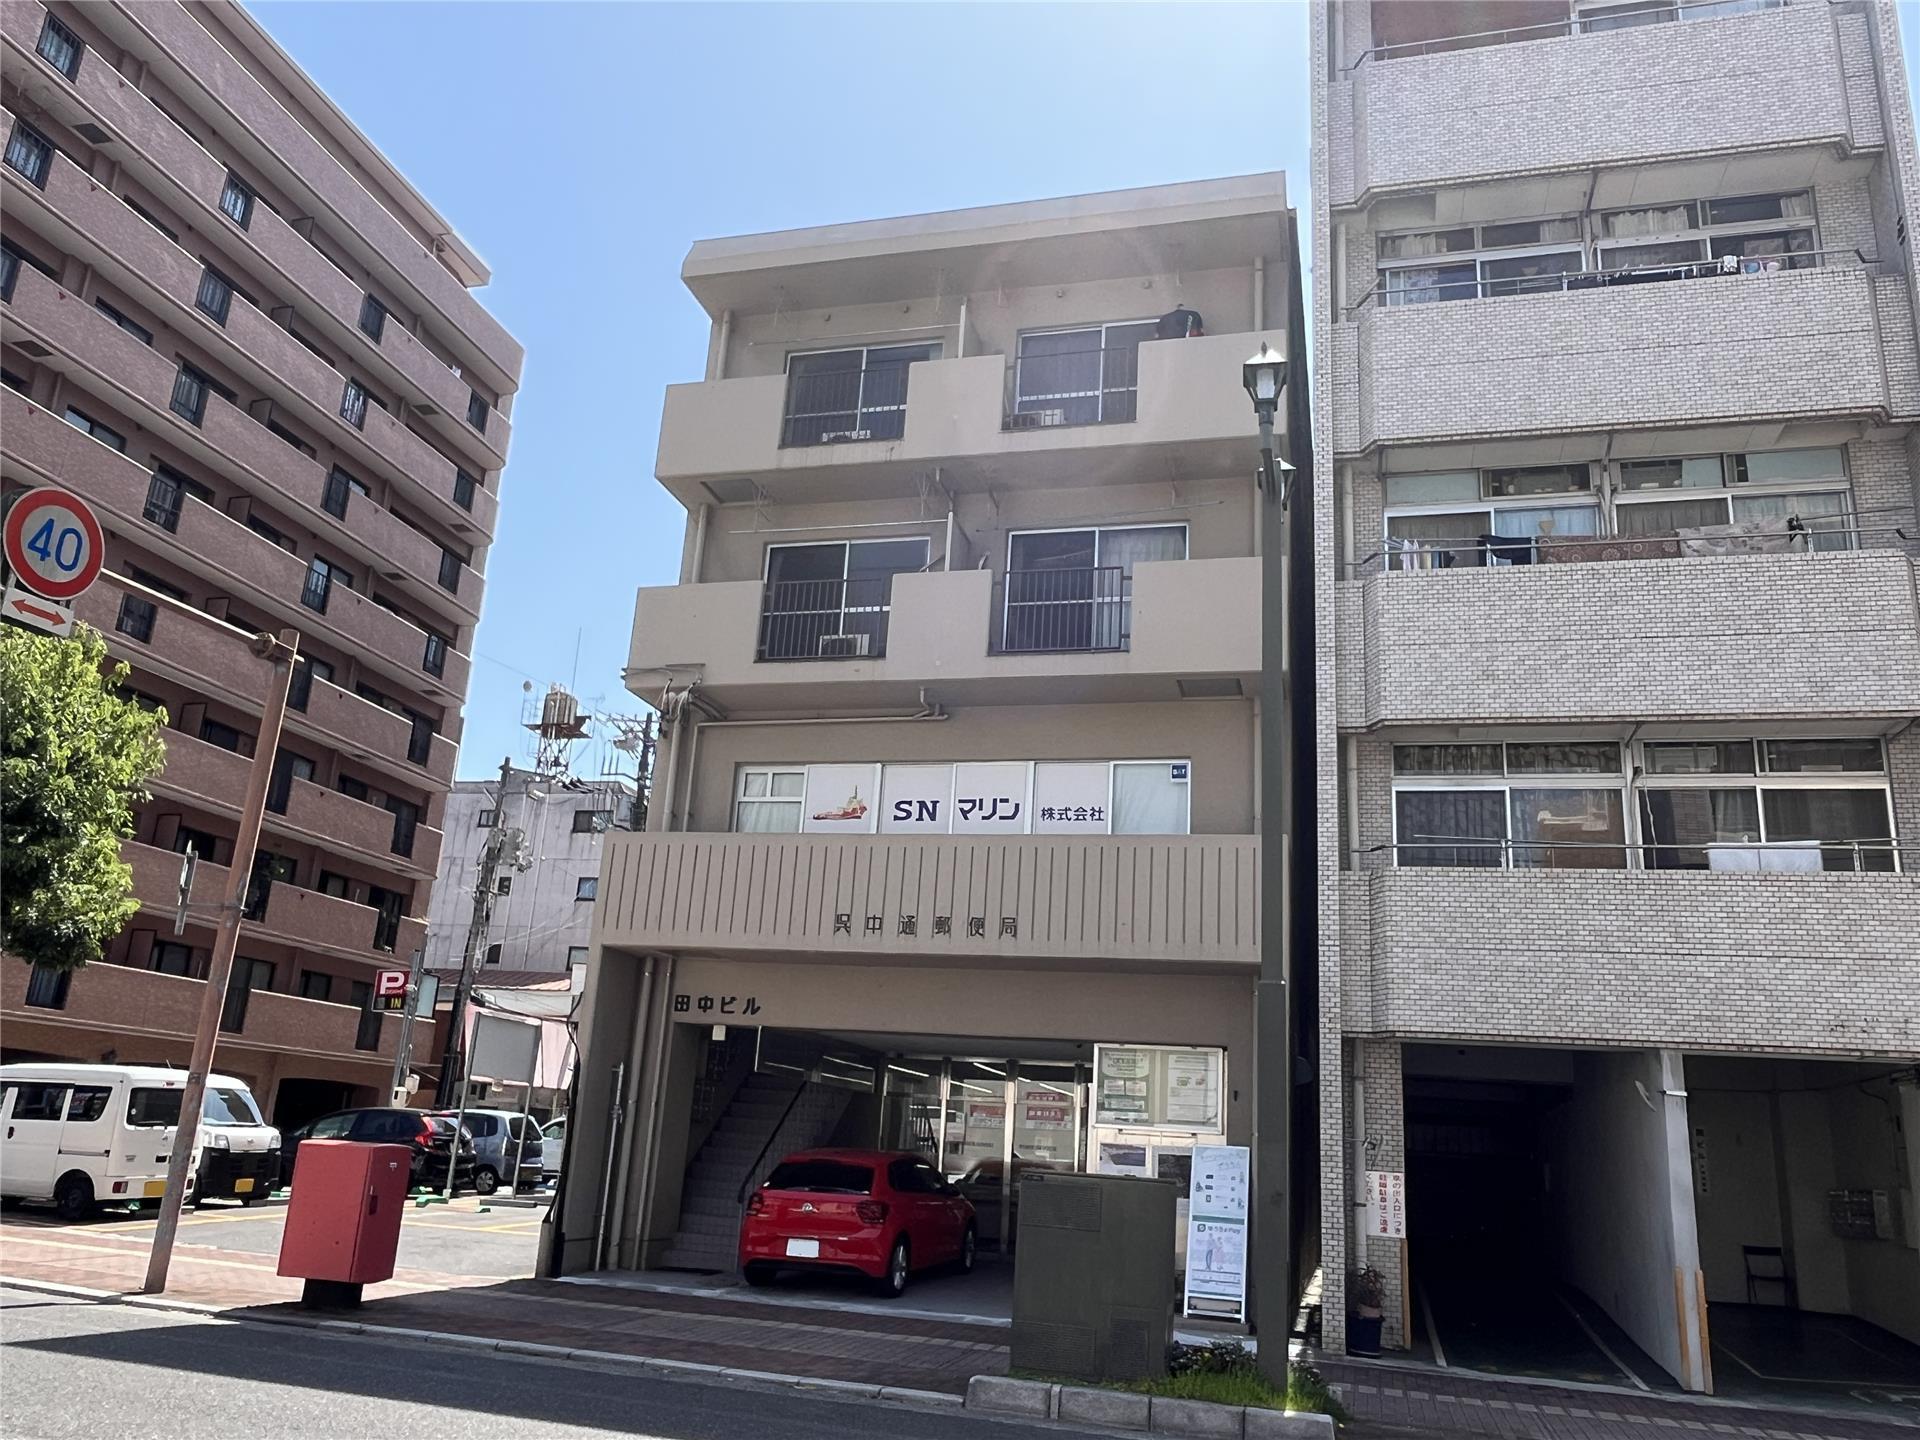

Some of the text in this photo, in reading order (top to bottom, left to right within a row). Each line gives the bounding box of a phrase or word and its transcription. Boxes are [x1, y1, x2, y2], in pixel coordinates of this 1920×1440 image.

[27, 518, 83, 572] 40
[893, 798, 1105, 822] SN マリン 株式会社
[835, 913, 1017, 938] 呉中通郵便局
[380, 972, 405, 995] P
[391, 997, 402, 1009] IN
[674, 994, 761, 1015] 田中ビル
